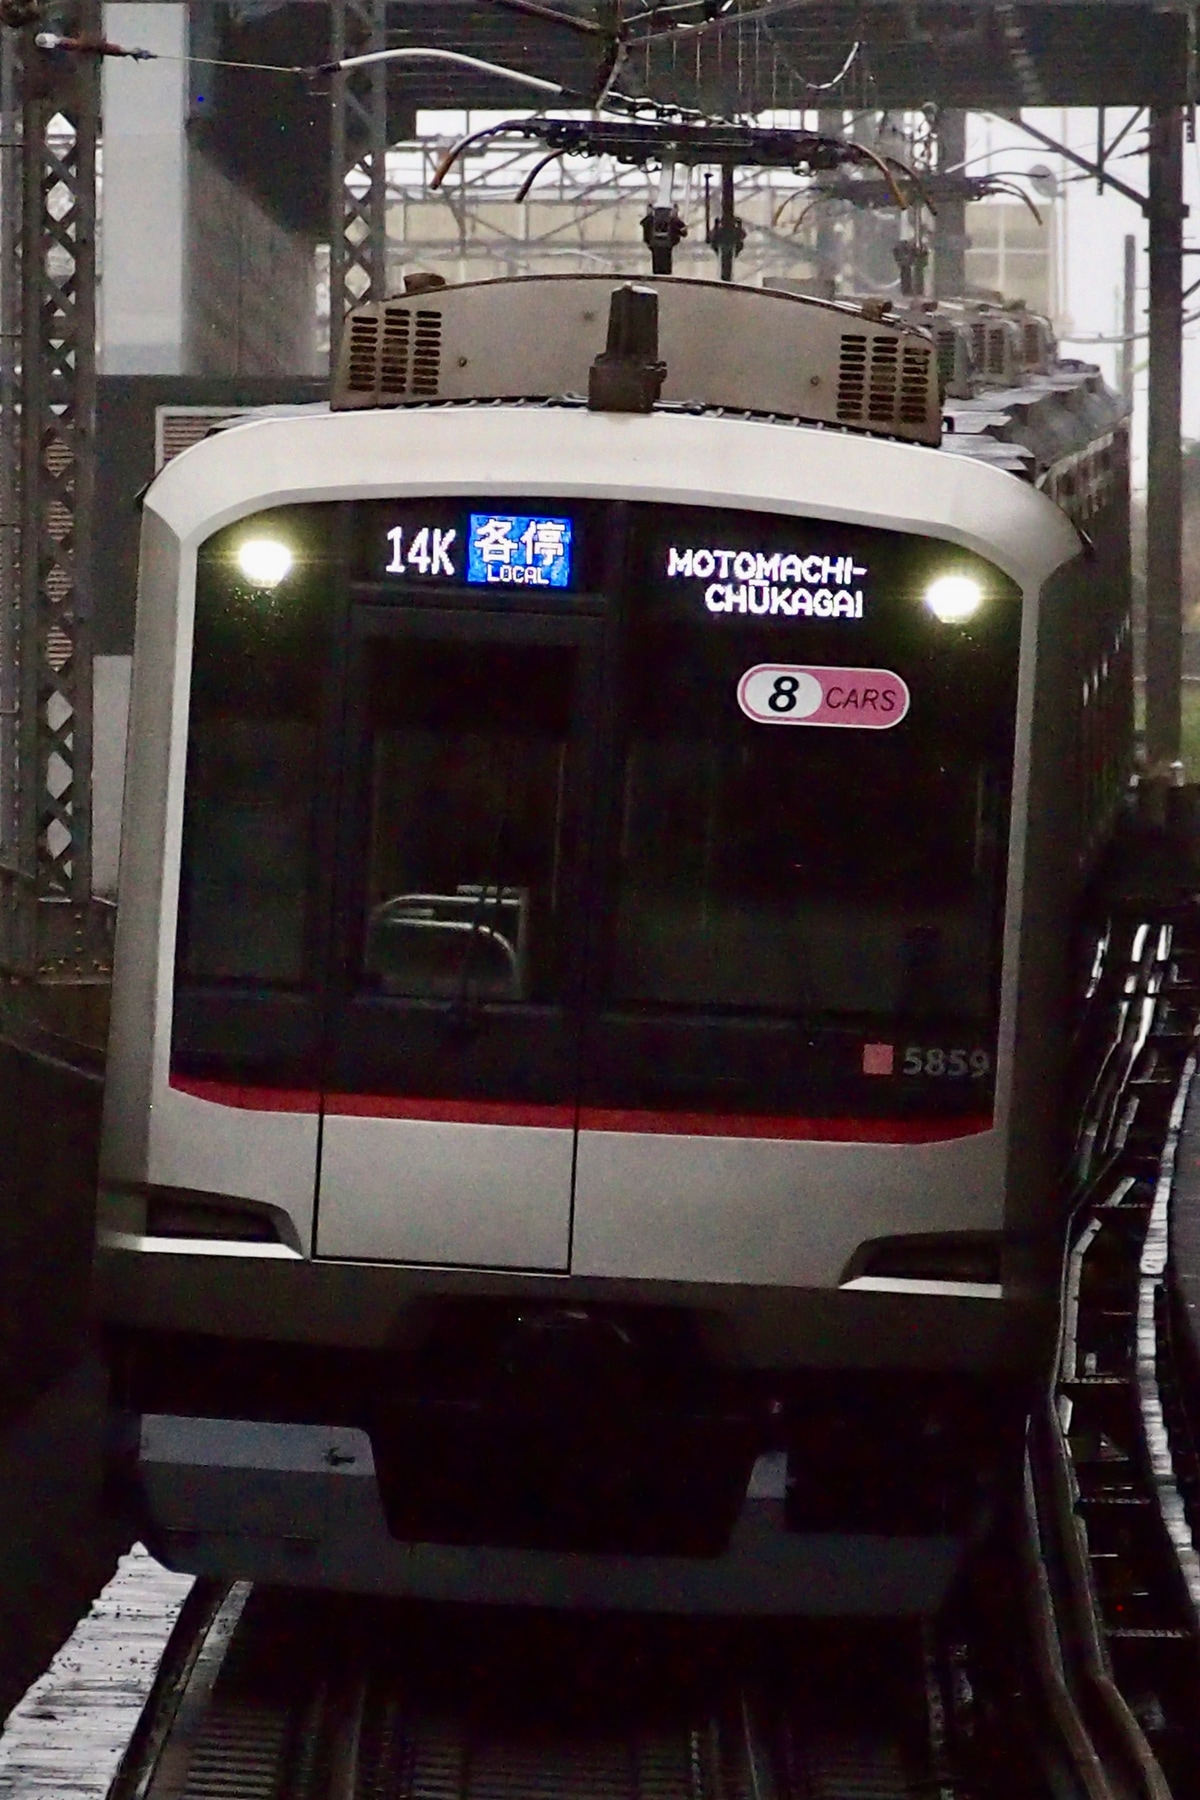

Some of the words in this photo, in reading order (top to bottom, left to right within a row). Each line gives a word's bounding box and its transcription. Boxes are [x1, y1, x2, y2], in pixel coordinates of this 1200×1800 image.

[386, 526, 457, 575] 14K
[474, 518, 566, 566] 各停
[487, 564, 550, 585] LOCAL
[667, 548, 868, 584] MOTOMACHI-
[705, 580, 863, 618] CHŪKAGAI
[768, 676, 800, 713] 8
[826, 687, 896, 712] CARS
[902, 1047, 990, 1078] 5859
